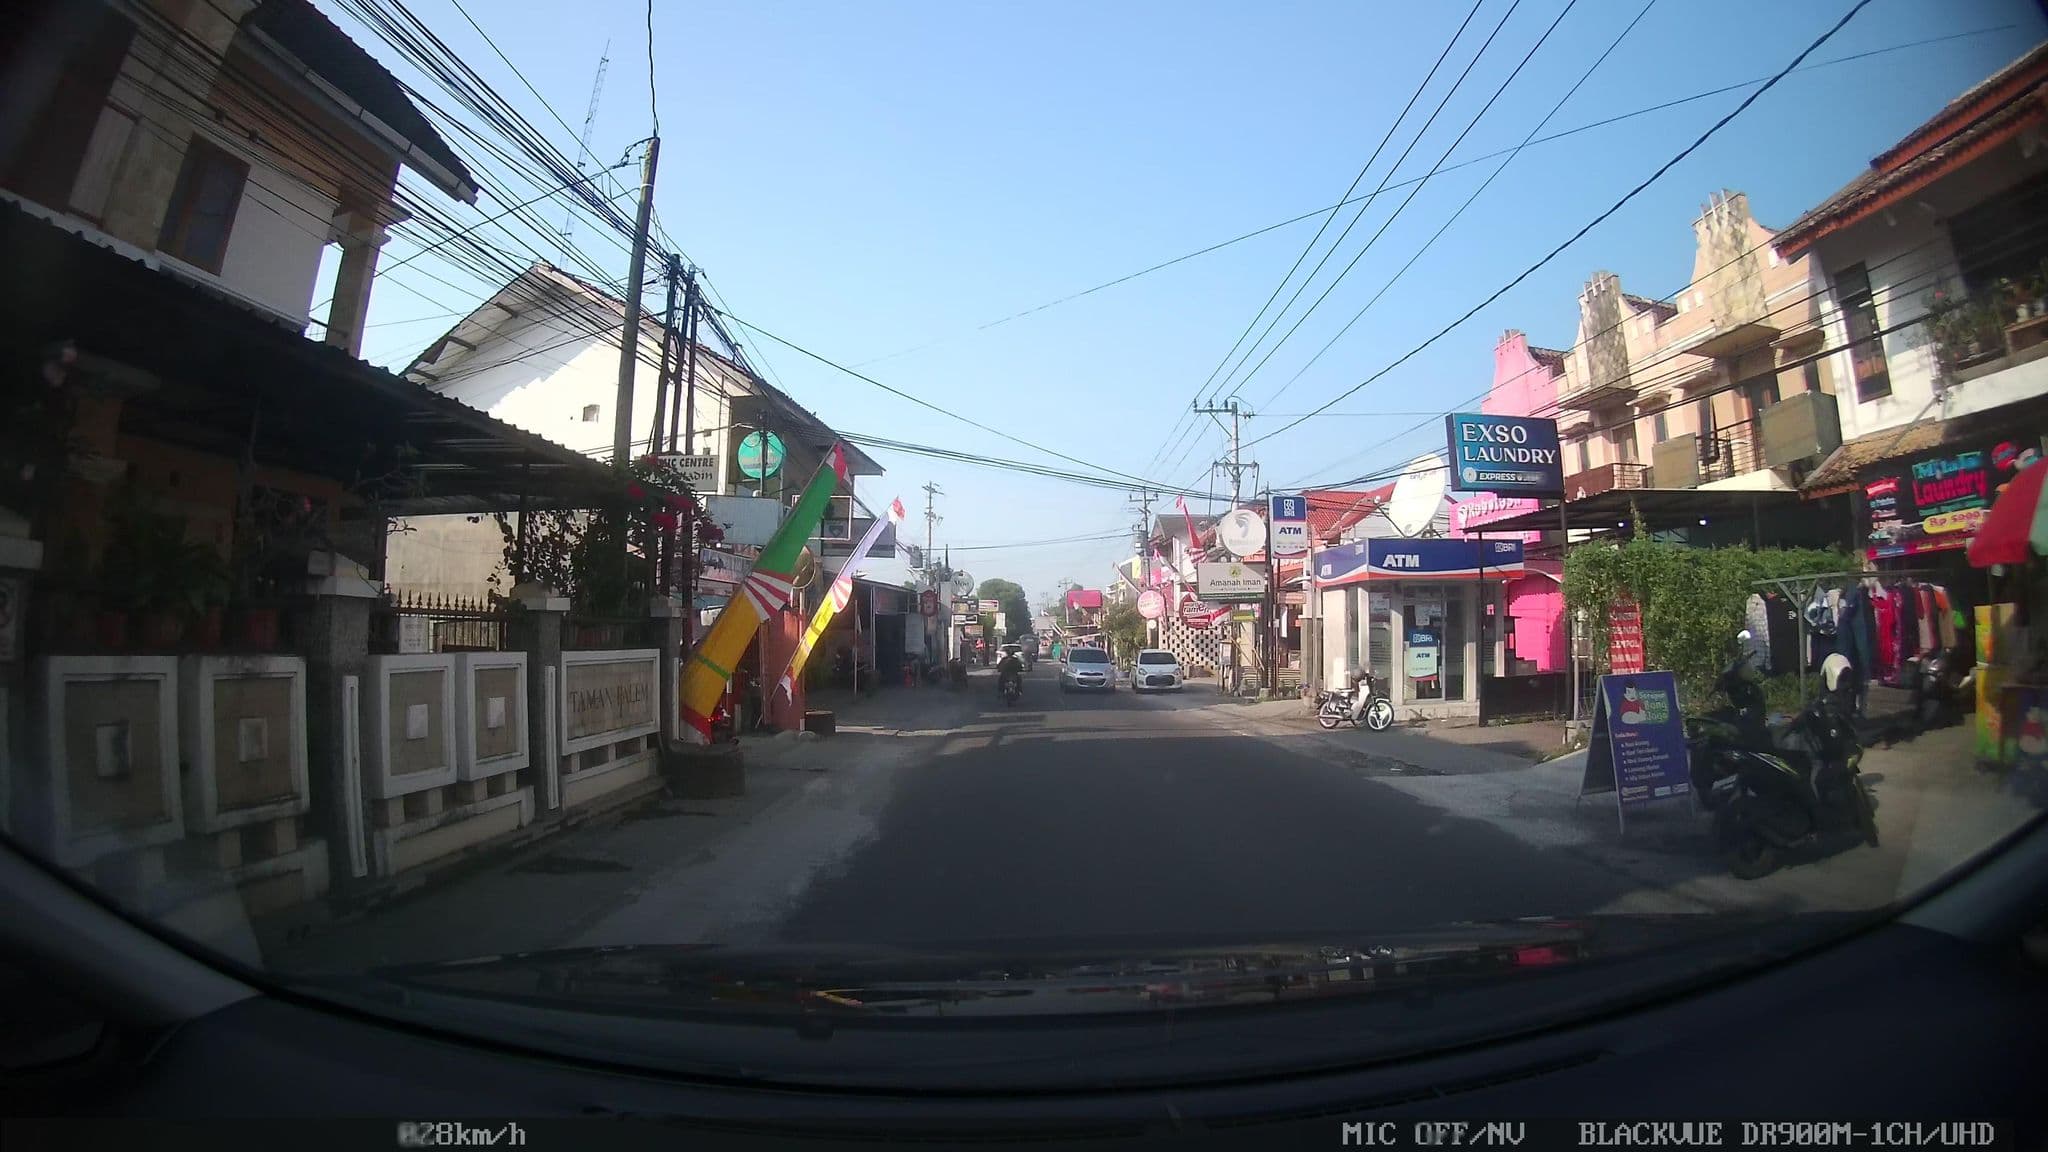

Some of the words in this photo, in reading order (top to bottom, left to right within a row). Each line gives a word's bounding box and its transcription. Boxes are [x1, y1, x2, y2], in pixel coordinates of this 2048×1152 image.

[1462, 423, 1527, 444] EXSO
[1463, 446, 1556, 464] LAUNDRY
[680, 457, 714, 468] CENTRE
[1479, 472, 1516, 481] EXPRESS
[1279, 526, 1302, 535] ATM
[1502, 543, 1517, 552] BRI
[1383, 554, 1420, 568] ATM
[1210, 579, 1241, 587] Amanah
[1420, 634, 1433, 642] BRI
[570, 687, 613, 713] TAMAN
